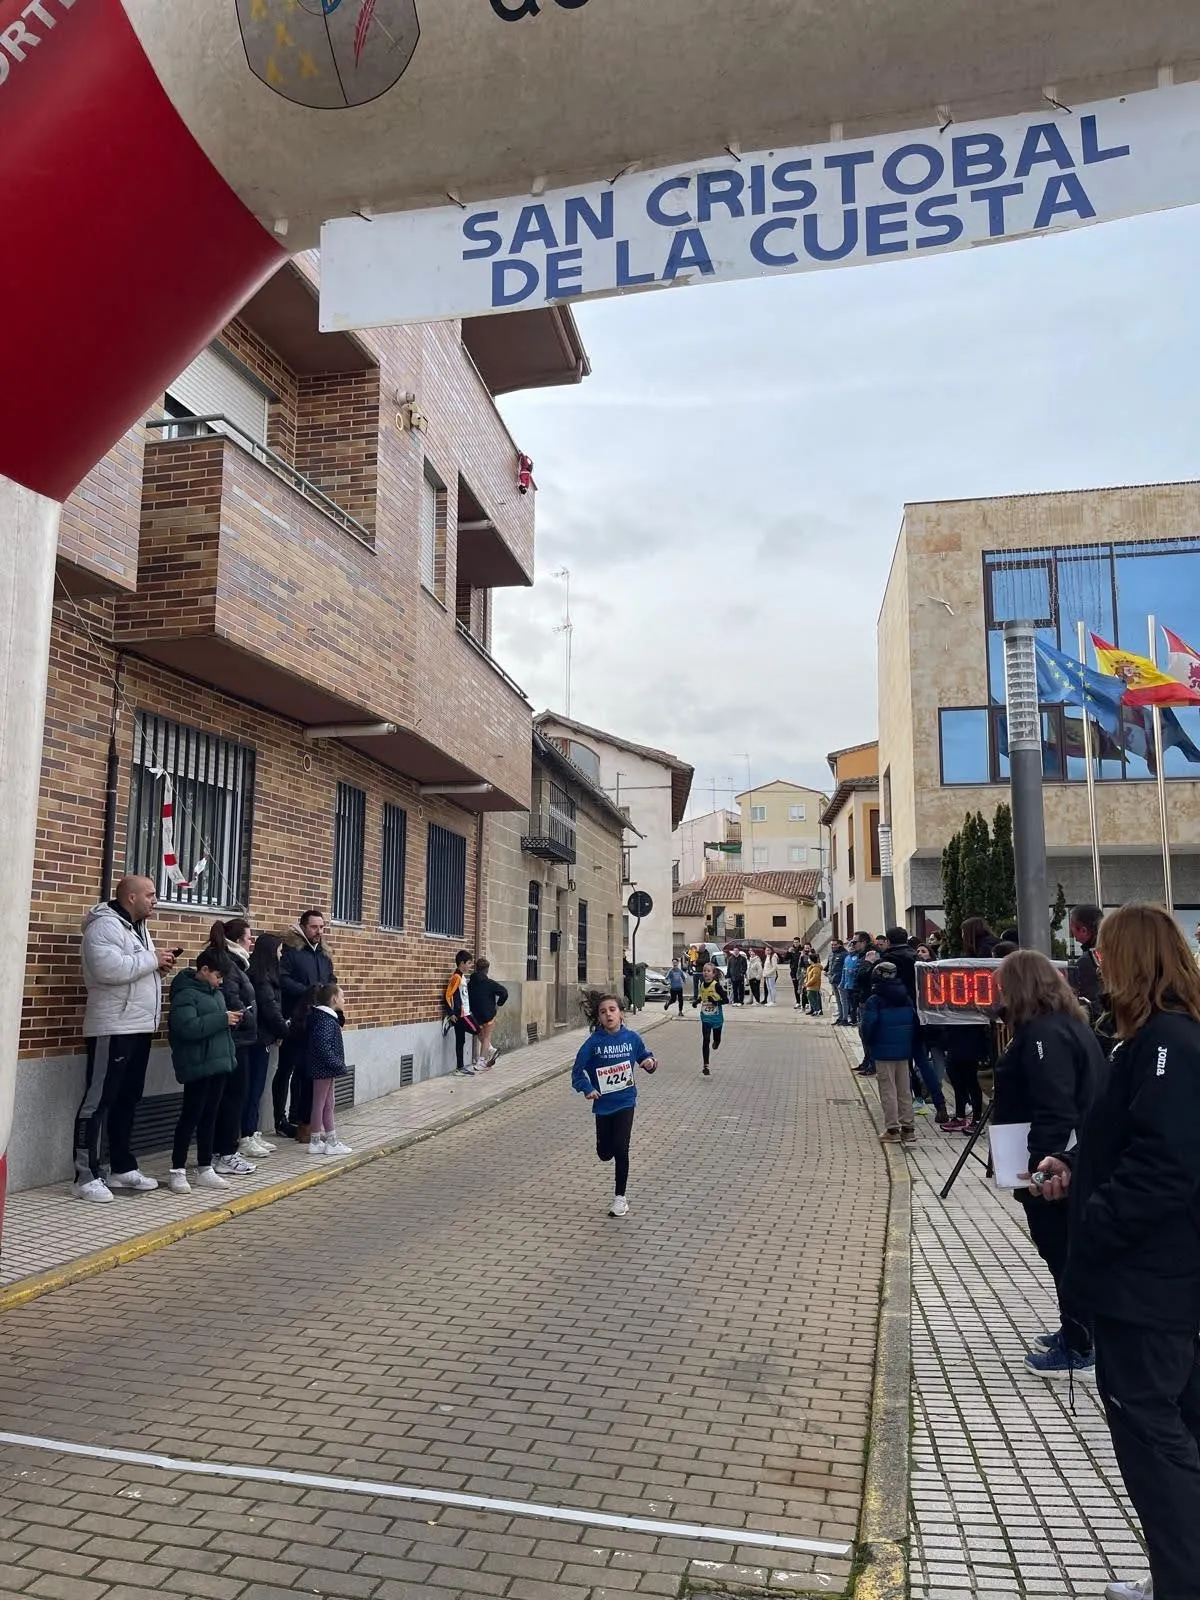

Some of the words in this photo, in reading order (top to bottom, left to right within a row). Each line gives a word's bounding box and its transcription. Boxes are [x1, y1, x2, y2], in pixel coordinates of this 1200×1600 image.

[462, 191, 614, 260] SAN
[646, 114, 1130, 227] CRISTOBAL
[491, 247, 583, 307] DE
[616, 228, 715, 287] LA
[750, 172, 1097, 267] CUESTA
[603, 1042, 633, 1055] ARMUÑA
[1156, 1046, 1168, 1077] Joma
[606, 1072, 627, 1086] 424
